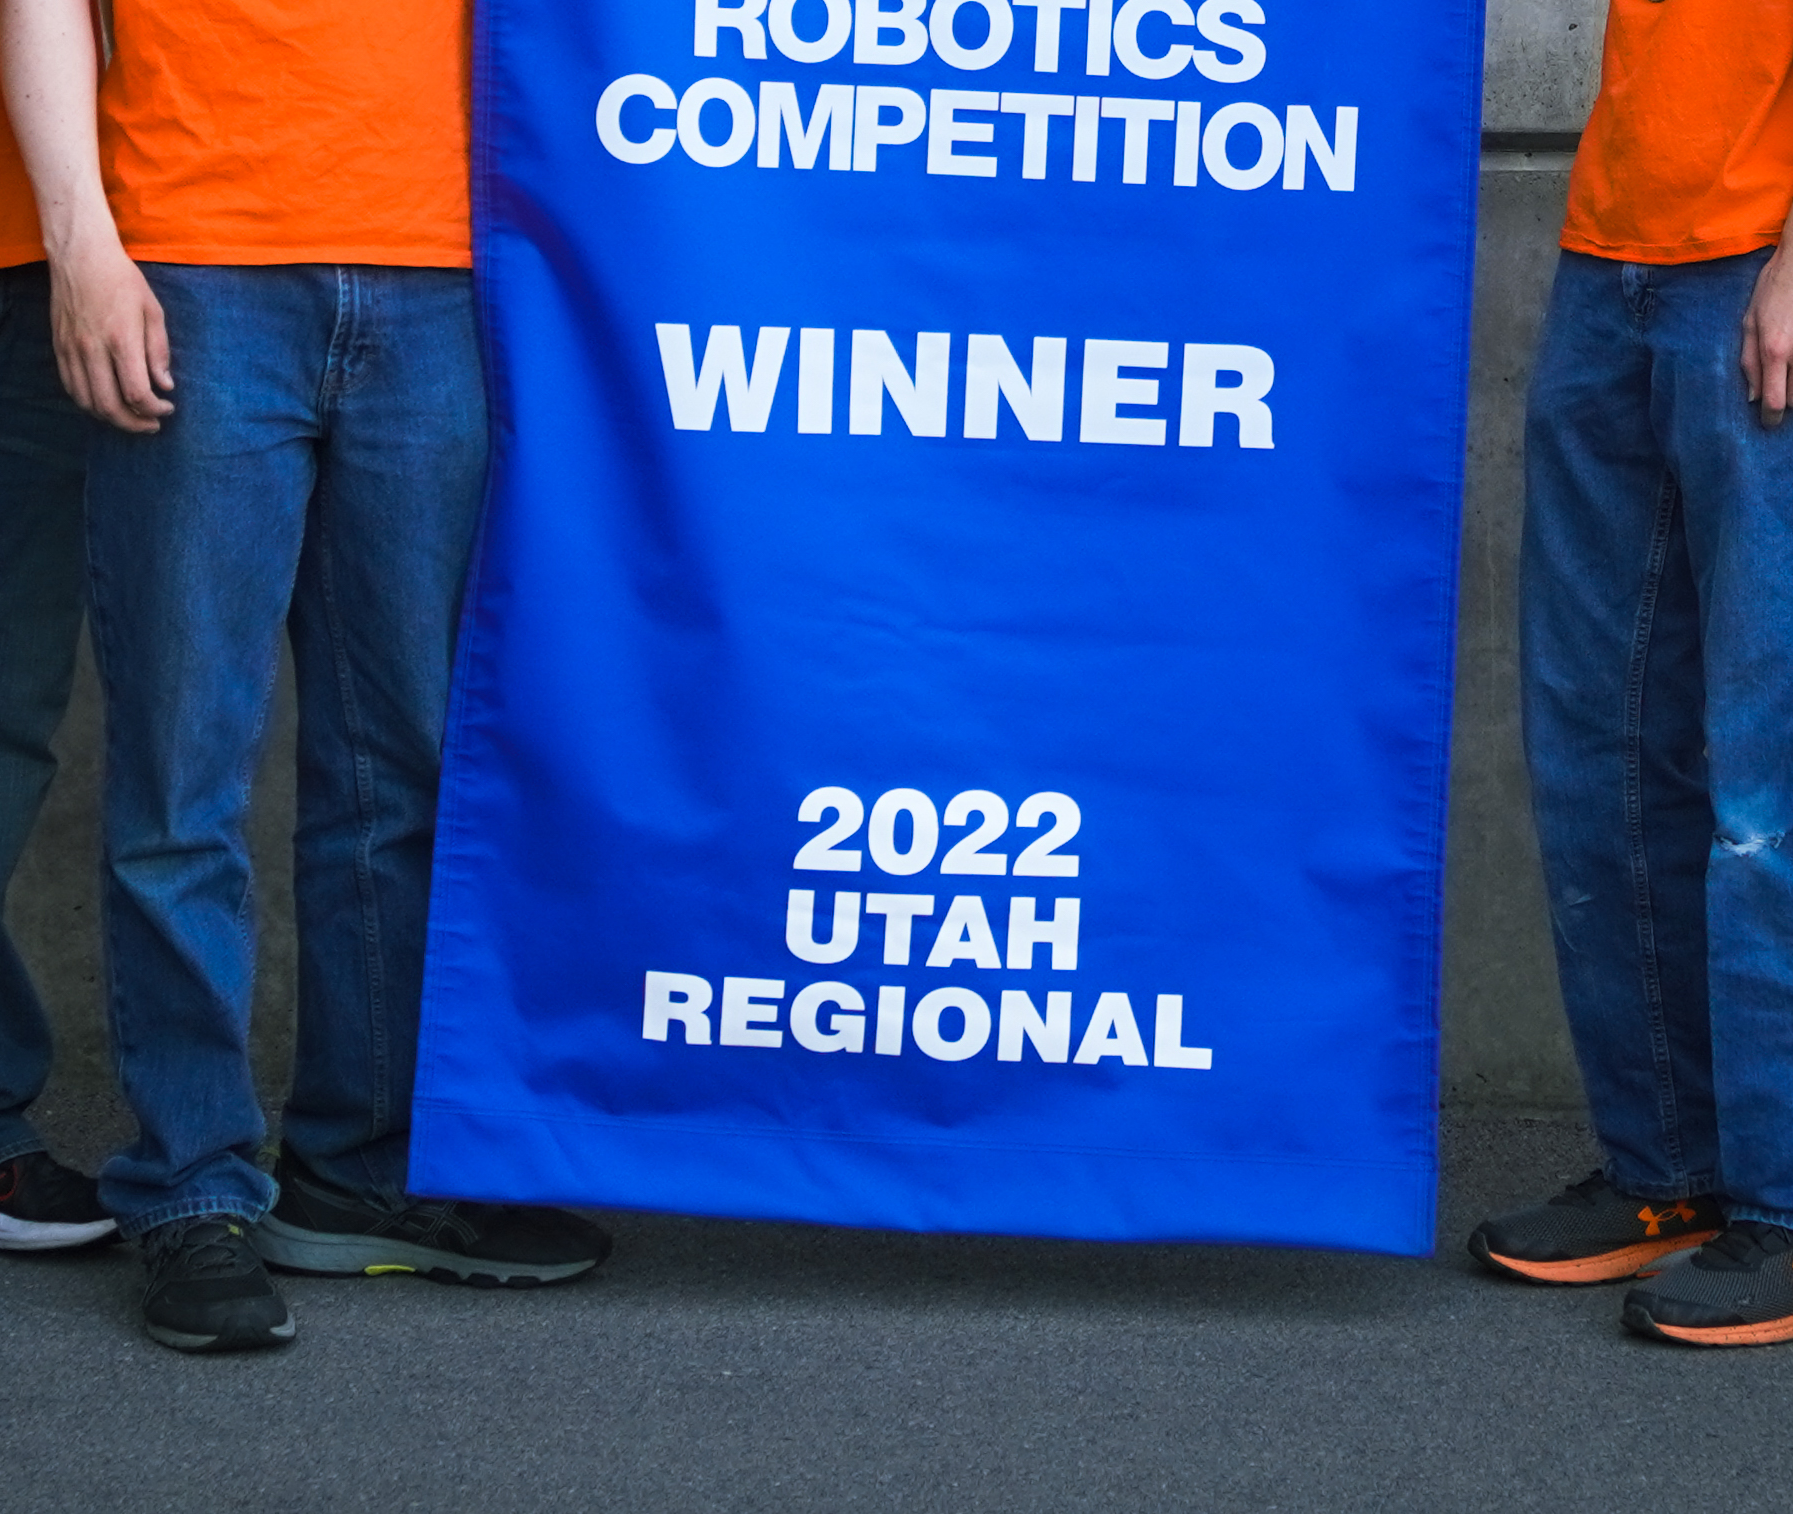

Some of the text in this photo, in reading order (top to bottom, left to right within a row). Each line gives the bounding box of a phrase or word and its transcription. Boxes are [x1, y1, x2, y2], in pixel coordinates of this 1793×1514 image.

[596, 74, 1358, 191] COMPETITION
[656, 323, 1274, 448] WINNER
[794, 787, 1080, 876] 2022
[786, 890, 1080, 970] UTAH
[643, 972, 1212, 1069] REGIONAL
